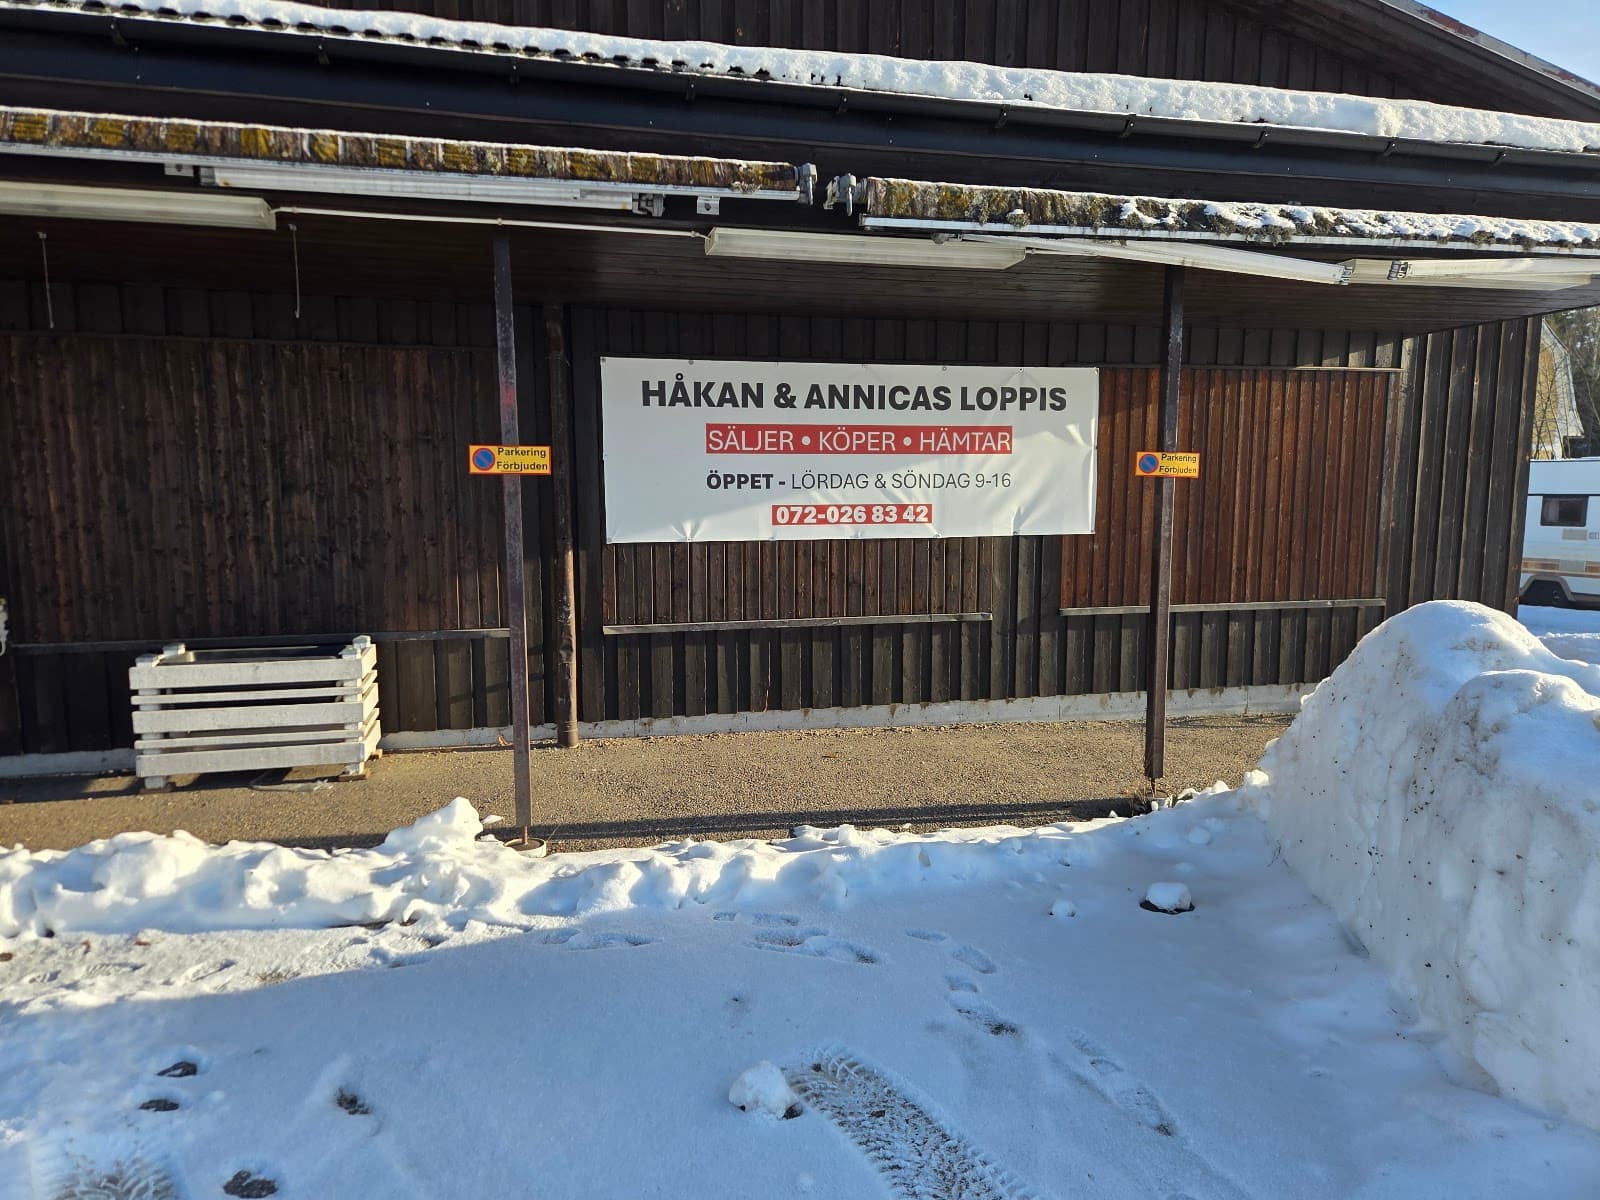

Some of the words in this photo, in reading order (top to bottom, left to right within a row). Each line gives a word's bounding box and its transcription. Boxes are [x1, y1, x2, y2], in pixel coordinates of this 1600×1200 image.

[641, 372, 764, 409] HÅKAN
[773, 382, 798, 409] &
[803, 383, 952, 411] ANNICAS
[960, 386, 1067, 412] LOPPIS
[708, 425, 795, 451] SÄLJER
[819, 426, 896, 451] KÖPER
[919, 427, 1011, 452] HÄMTAR
[497, 447, 546, 459] Parkering
[1161, 453, 1197, 464] Parkering
[496, 460, 548, 471] Förbjuden
[1159, 465, 1197, 475] Förbjuden
[706, 469, 774, 490] ÖPPET
[791, 469, 869, 489] LÖRDAG
[874, 473, 887, 489] &
[891, 469, 971, 489] SÖNDAG
[975, 472, 1012, 488] 9-16
[776, 505, 867, 524] 072-026
[871, 505, 898, 523] 83
[902, 505, 929, 523] 42
